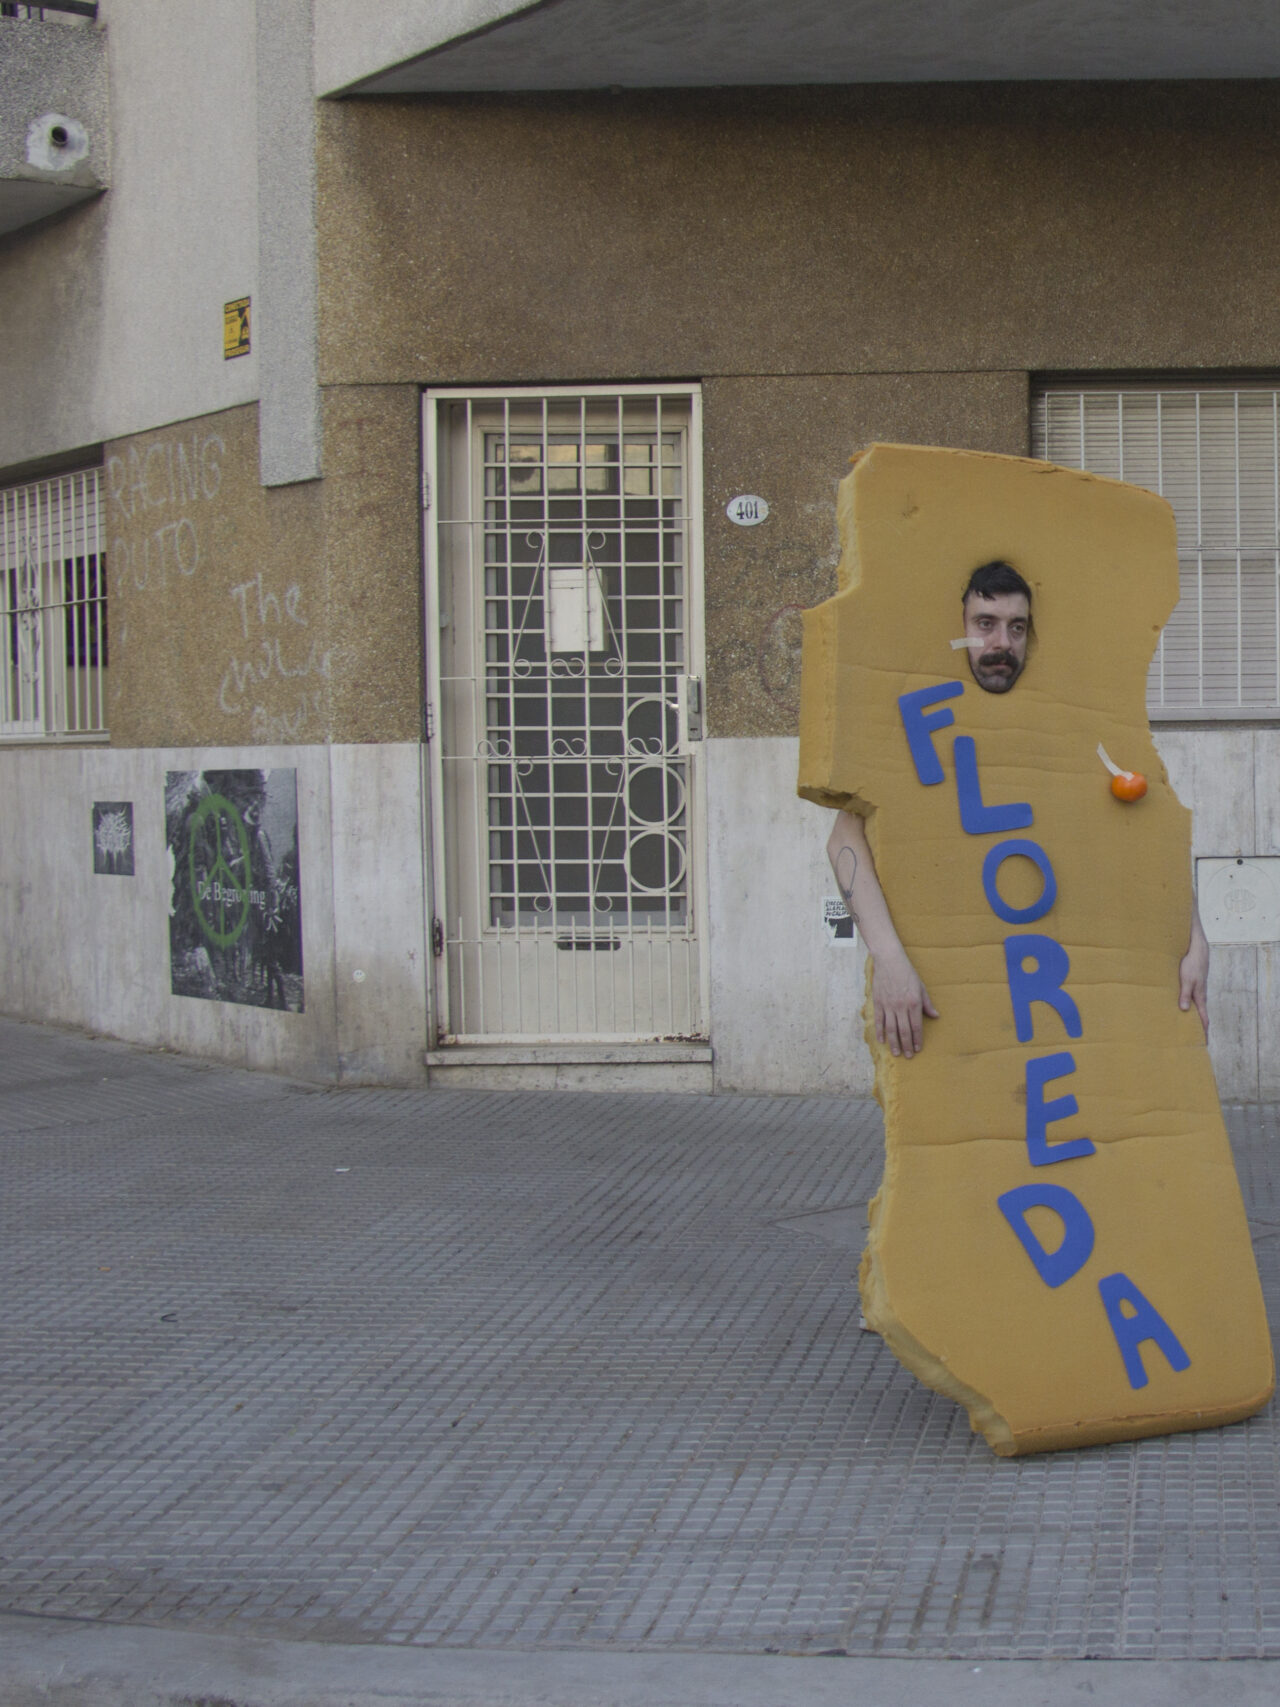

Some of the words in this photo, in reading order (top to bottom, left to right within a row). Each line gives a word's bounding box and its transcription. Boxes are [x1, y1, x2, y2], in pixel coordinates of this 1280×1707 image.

[736, 501, 759, 520] 401
[231, 573, 308, 638] The
[197, 880, 211, 900] De
[899, 680, 1191, 1389] FLOREDA
